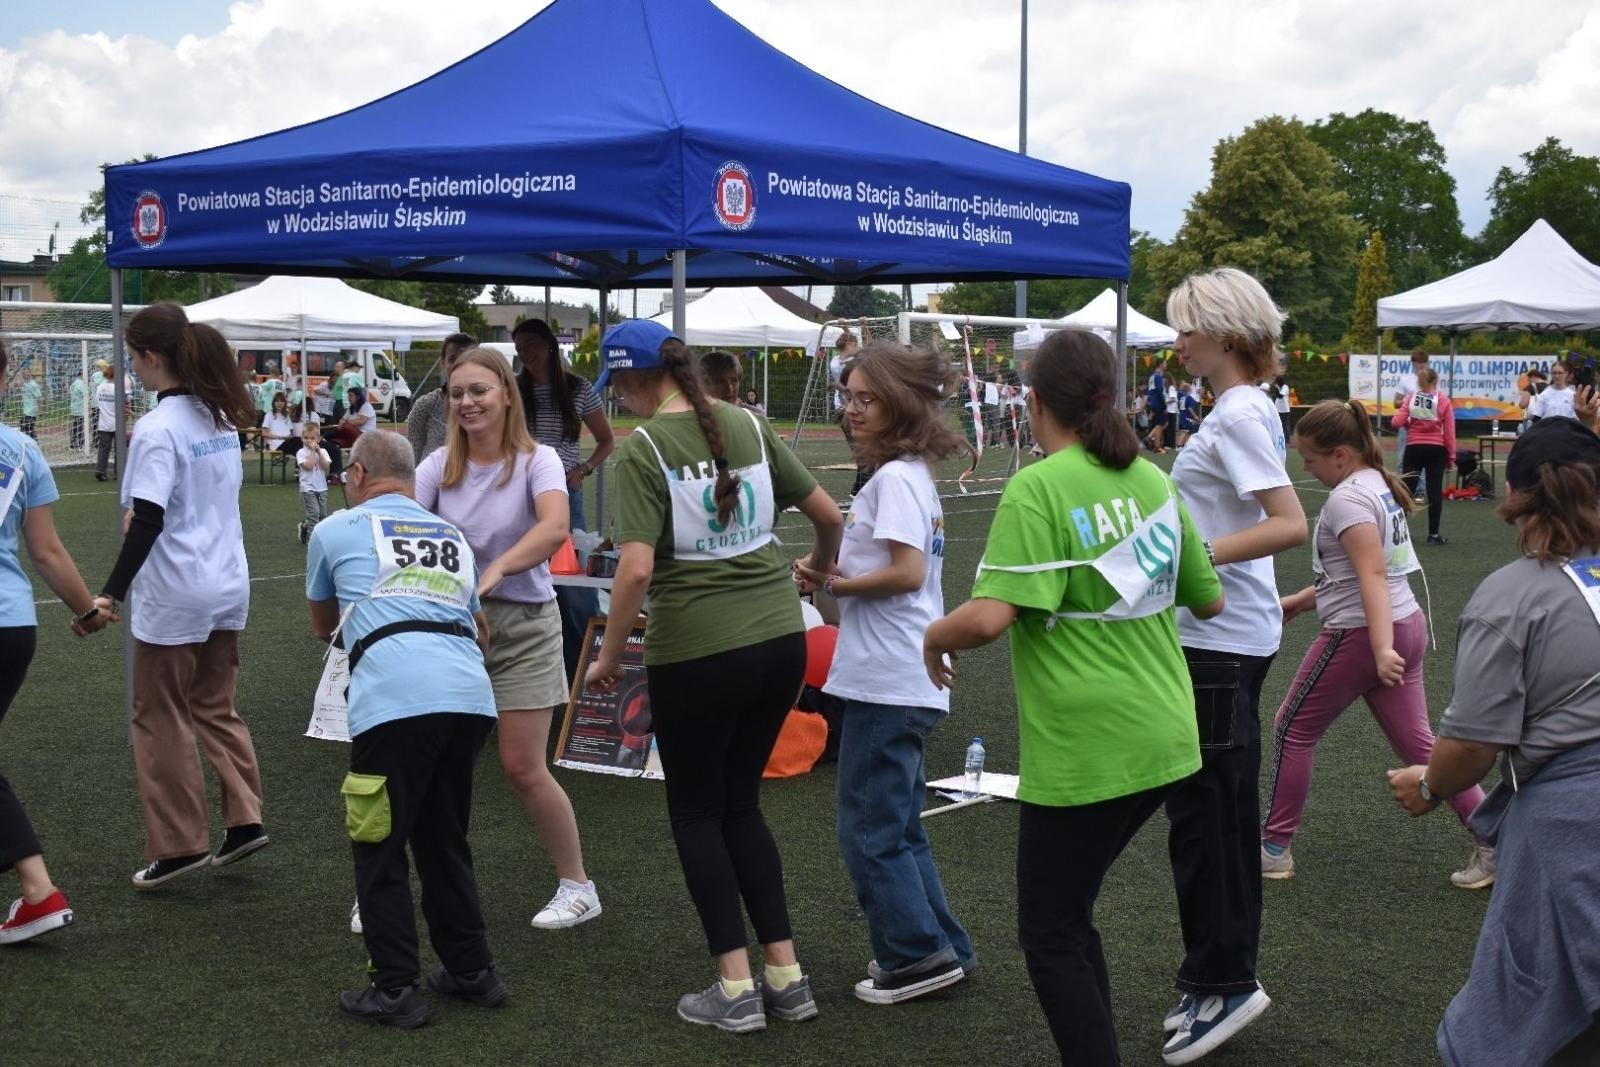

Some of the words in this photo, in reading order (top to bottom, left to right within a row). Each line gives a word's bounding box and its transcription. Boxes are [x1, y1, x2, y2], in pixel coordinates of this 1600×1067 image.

[178, 191, 261, 212] Powiatowa
[265, 184, 315, 209] Stacja
[319, 171, 576, 203] Sanitarno-Epidemiologiczna
[768, 171, 852, 201] Powiatowa
[856, 181, 900, 210] Stacja
[904, 186, 1080, 227] Sanitarno-Epidemiologiczna
[267, 219, 280, 234] w
[284, 209, 389, 233] Wodzisławiu
[394, 202, 466, 232] Śląskim
[857, 215, 870, 232] w
[873, 212, 959, 240] Wodzisławiu
[962, 216, 1013, 247] Śląskim
[608, 349, 627, 358] MAM
[1380, 360, 1463, 375] POWIOWA
[391, 539, 460, 574] 538
